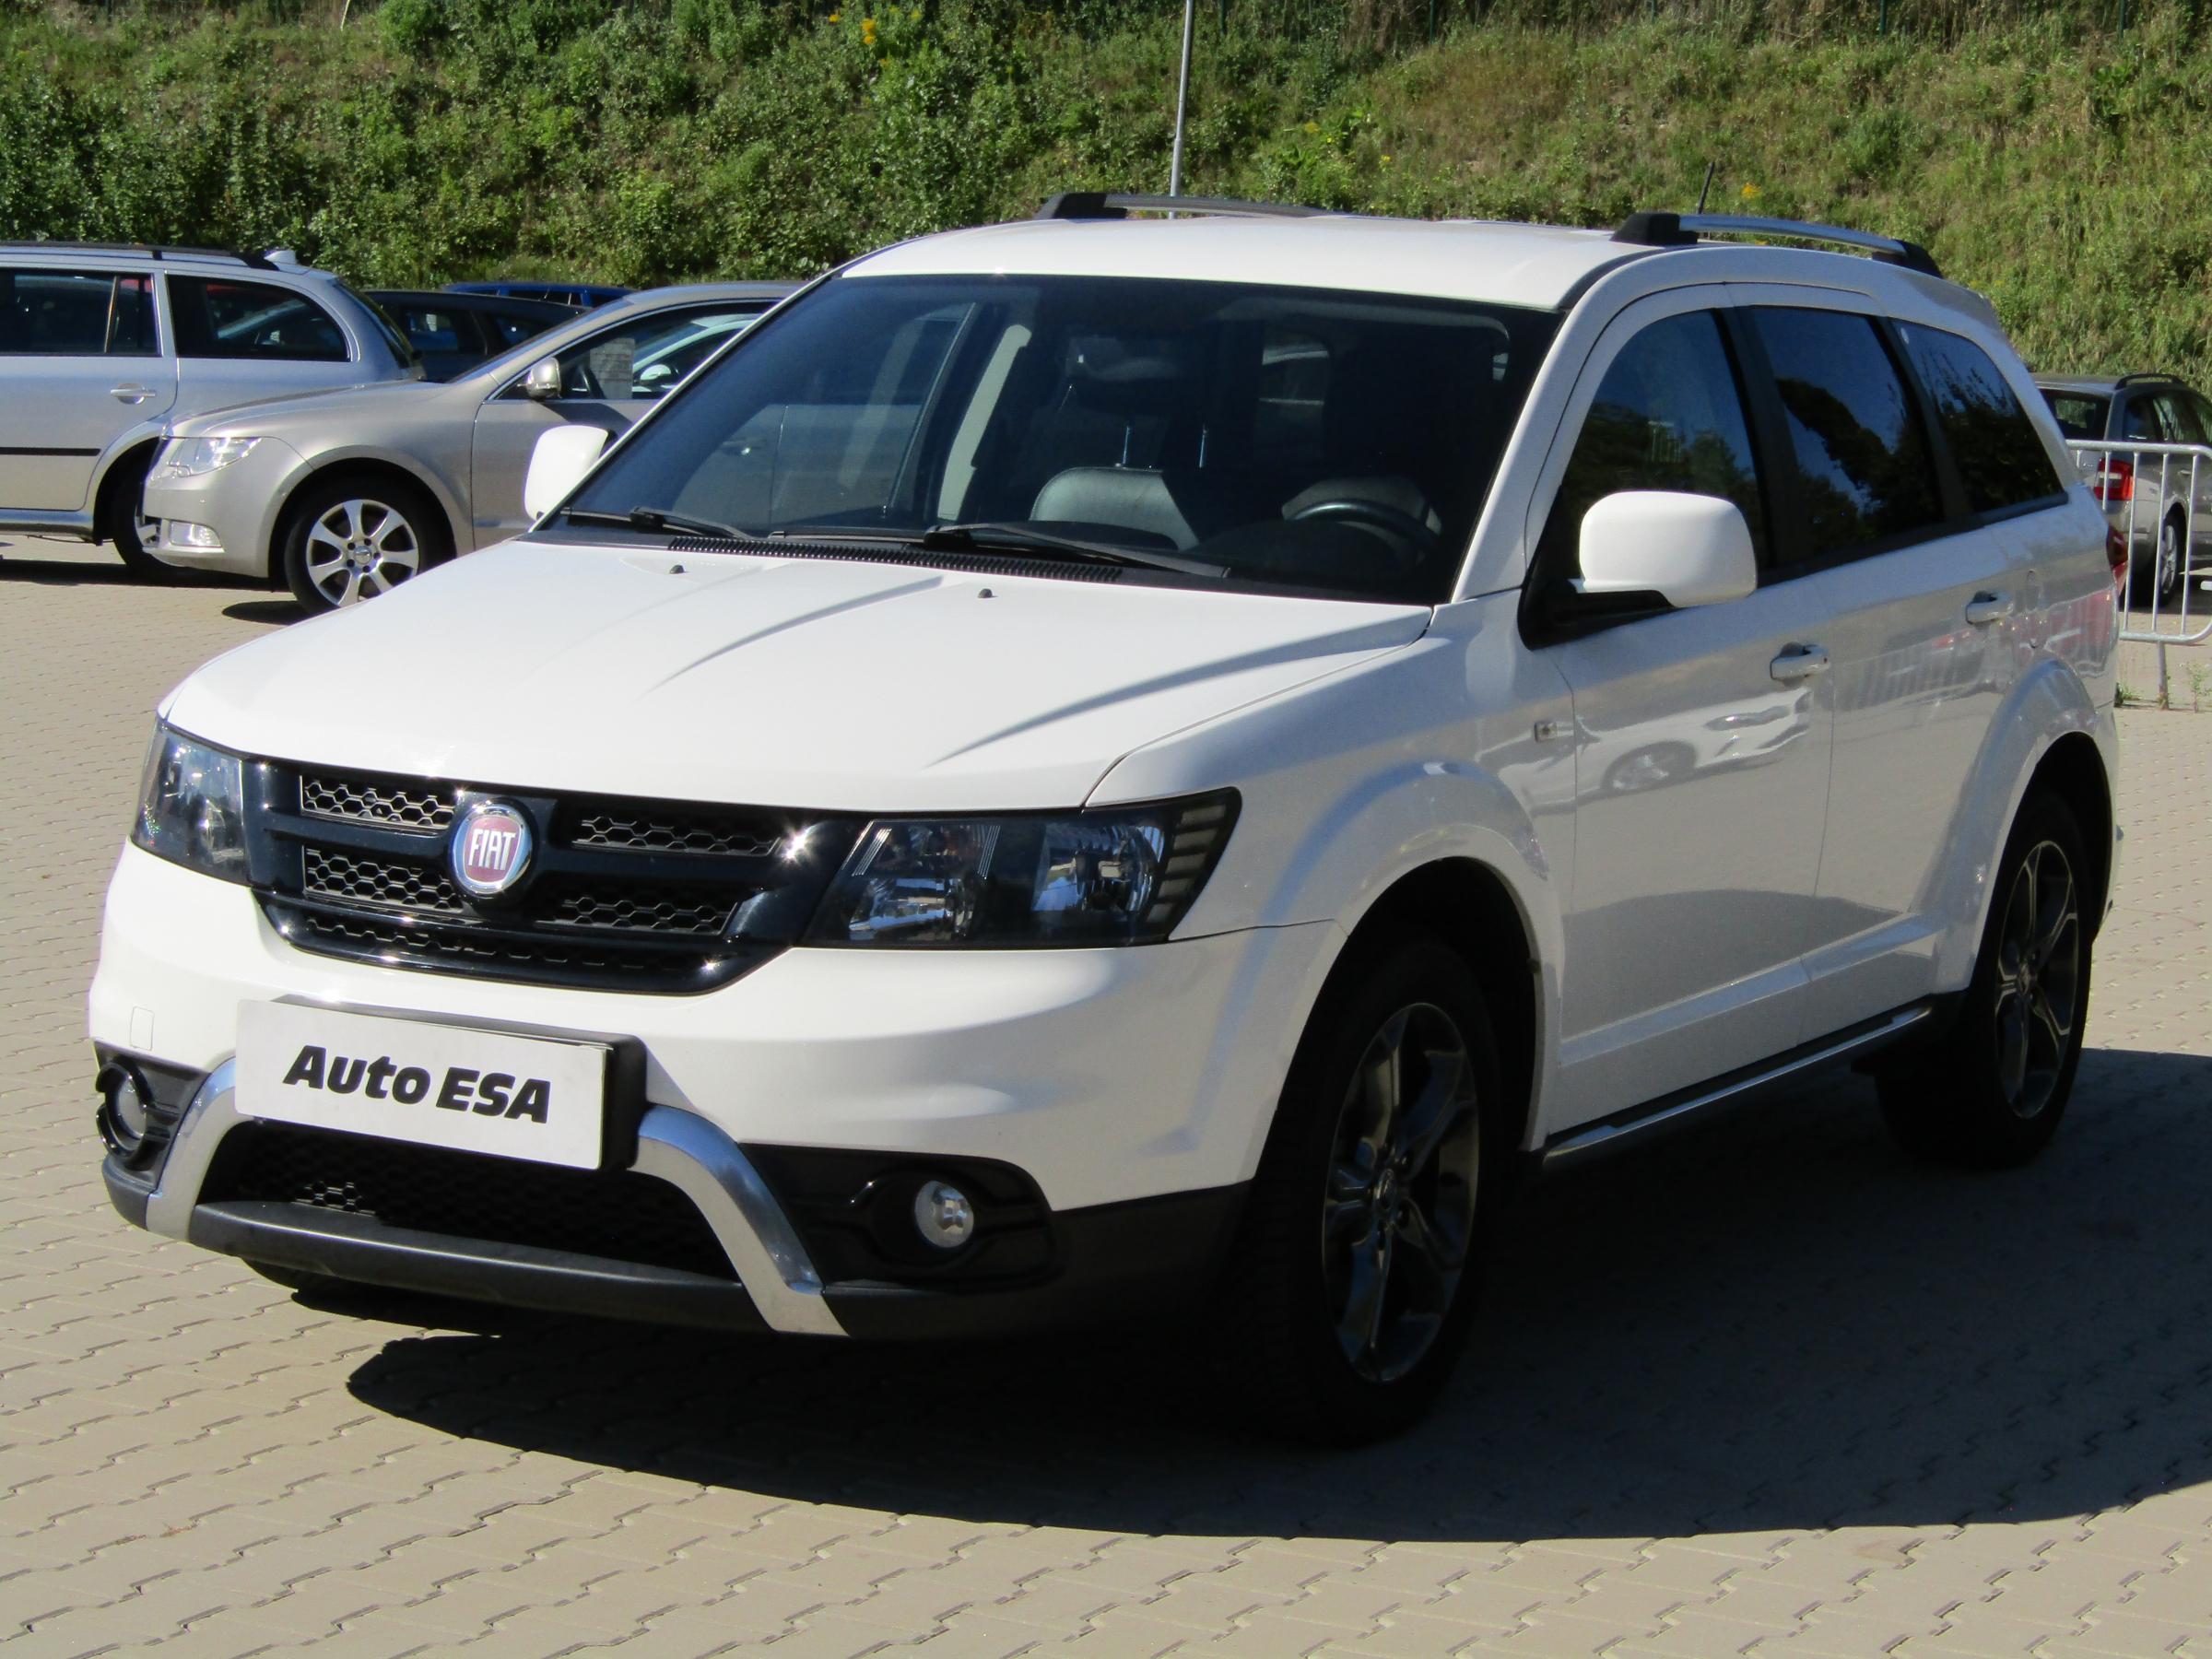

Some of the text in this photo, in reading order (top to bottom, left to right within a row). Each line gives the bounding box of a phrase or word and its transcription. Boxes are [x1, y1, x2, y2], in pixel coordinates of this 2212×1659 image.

[468, 829, 516, 870] FIAT
[282, 1044, 551, 1124] Auto ESA
